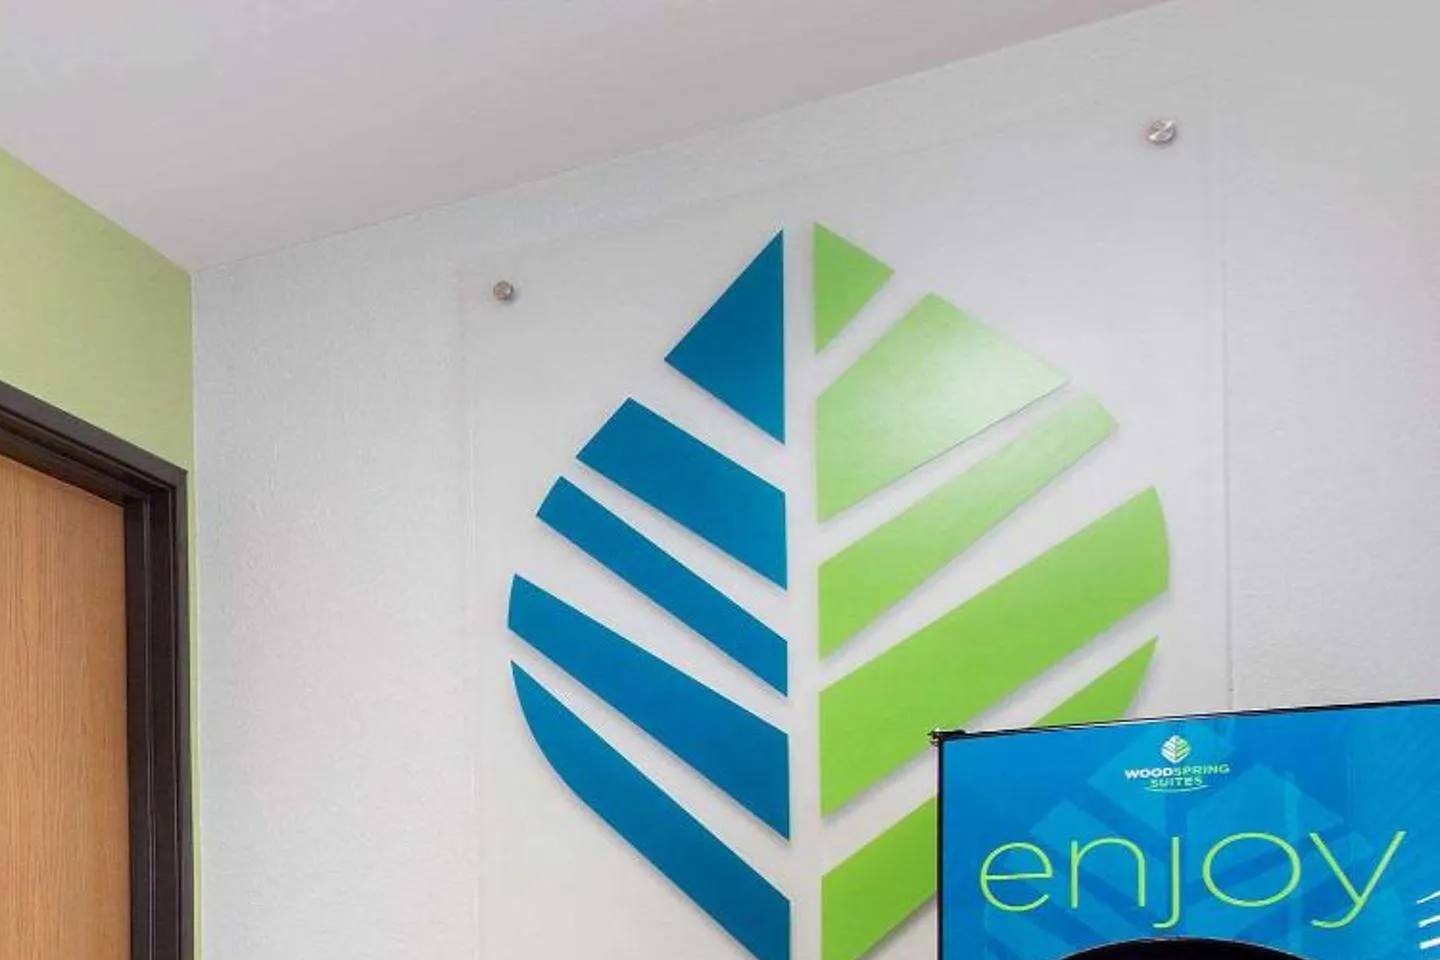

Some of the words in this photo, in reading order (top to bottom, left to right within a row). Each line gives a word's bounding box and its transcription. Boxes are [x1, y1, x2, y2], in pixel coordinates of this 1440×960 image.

[1124, 763, 1231, 779] WOODSPRING
[1151, 776, 1203, 788] SUITES
[979, 830, 1407, 929] enjoy
